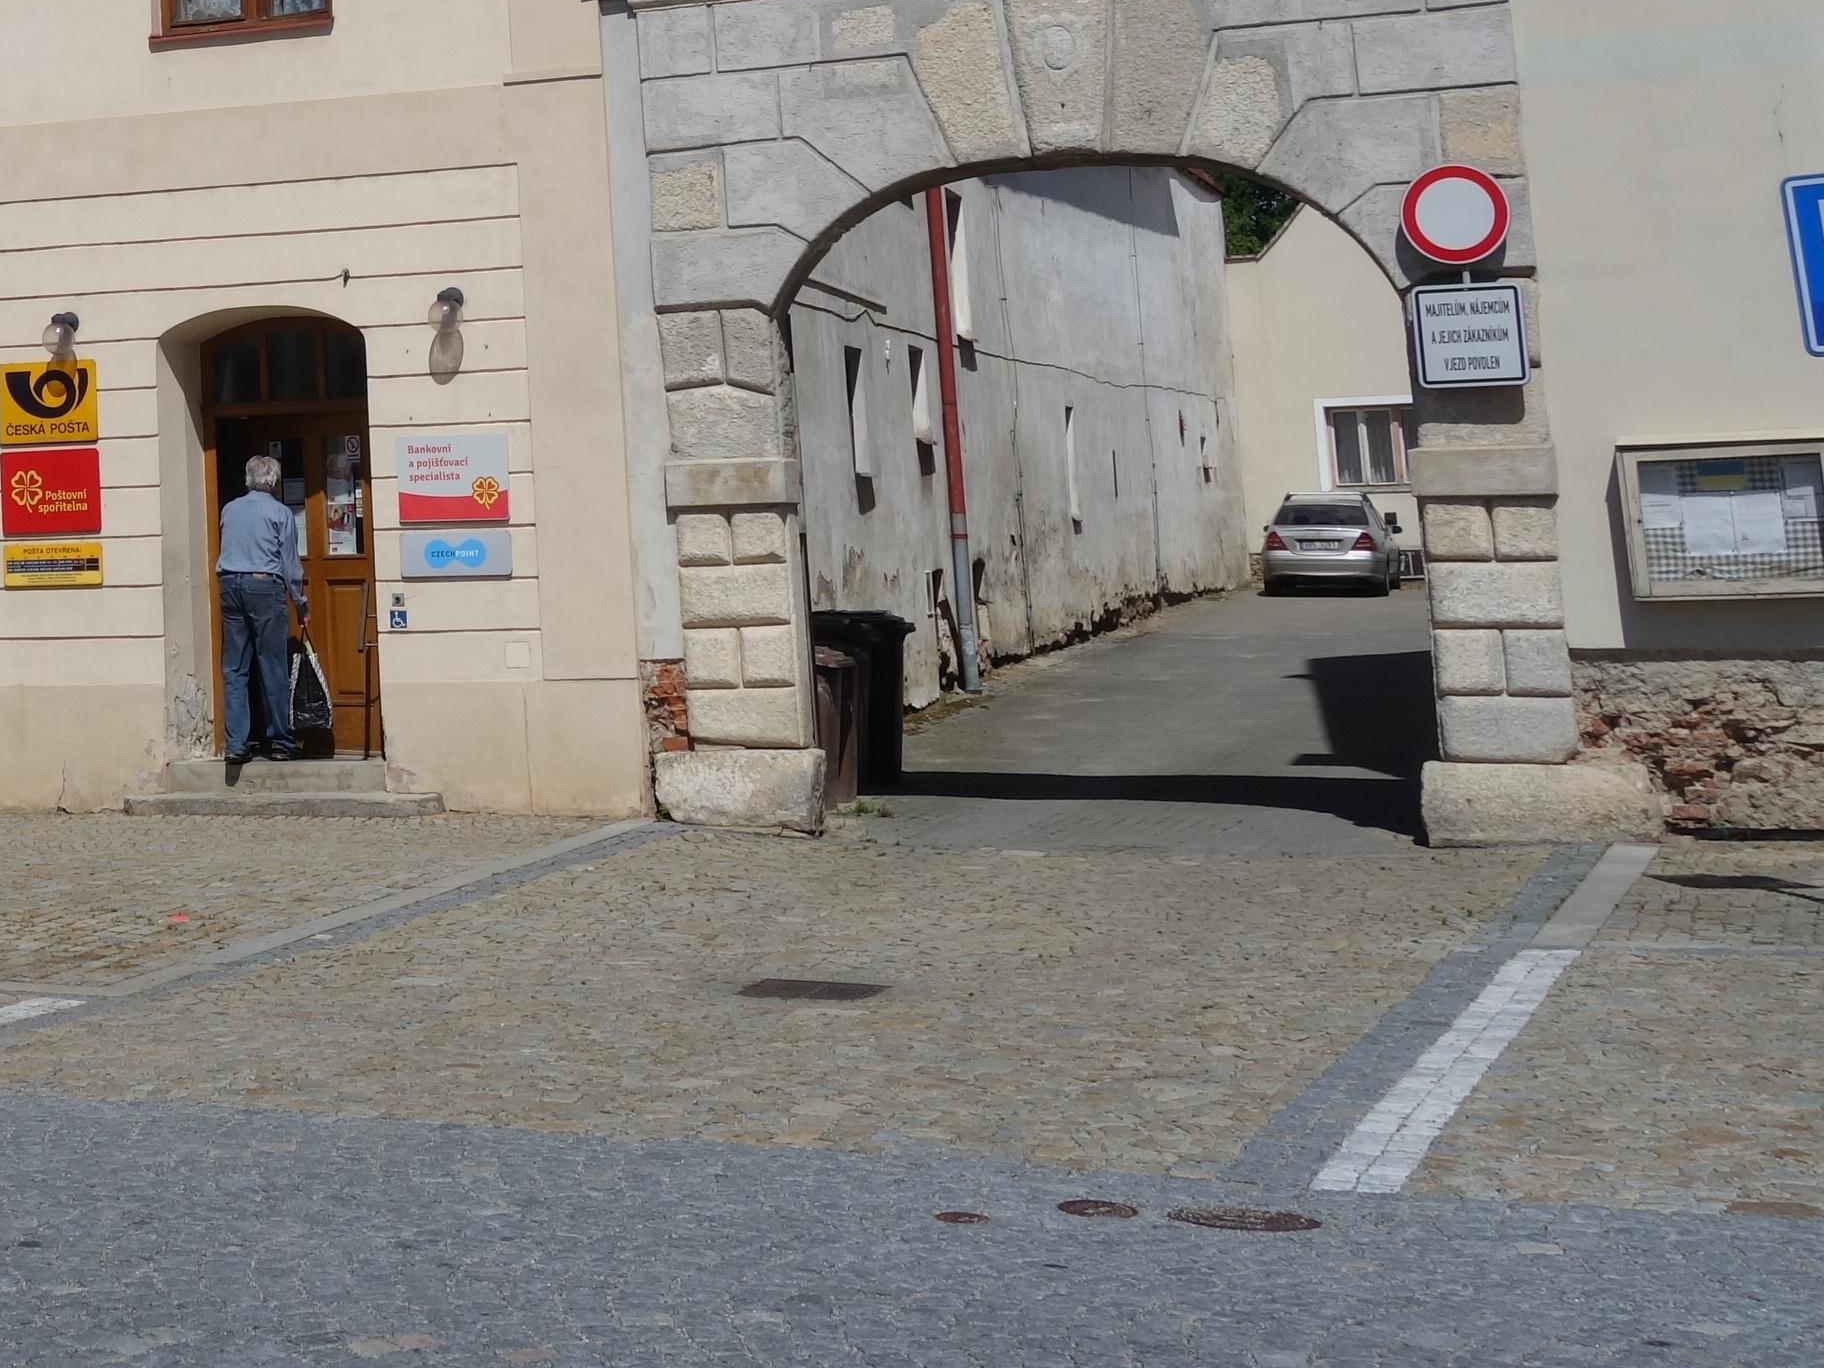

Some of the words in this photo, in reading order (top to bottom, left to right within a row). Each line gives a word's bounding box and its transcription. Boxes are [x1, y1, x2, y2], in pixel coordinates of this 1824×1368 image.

[1431, 330, 1437, 344] A
[1438, 329, 1462, 344] JEJICH
[1443, 357, 1466, 371] VJEZD
[1467, 355, 1500, 370] POVOLEN
[6, 421, 46, 436] ČESKÁ
[50, 419, 90, 434] POŠTA
[407, 443, 452, 454] Bankovní
[416, 456, 468, 469] pojišťovací
[408, 472, 461, 483] specialista
[45, 489, 87, 501] Poštovní
[38, 501, 88, 515] spořitelna
